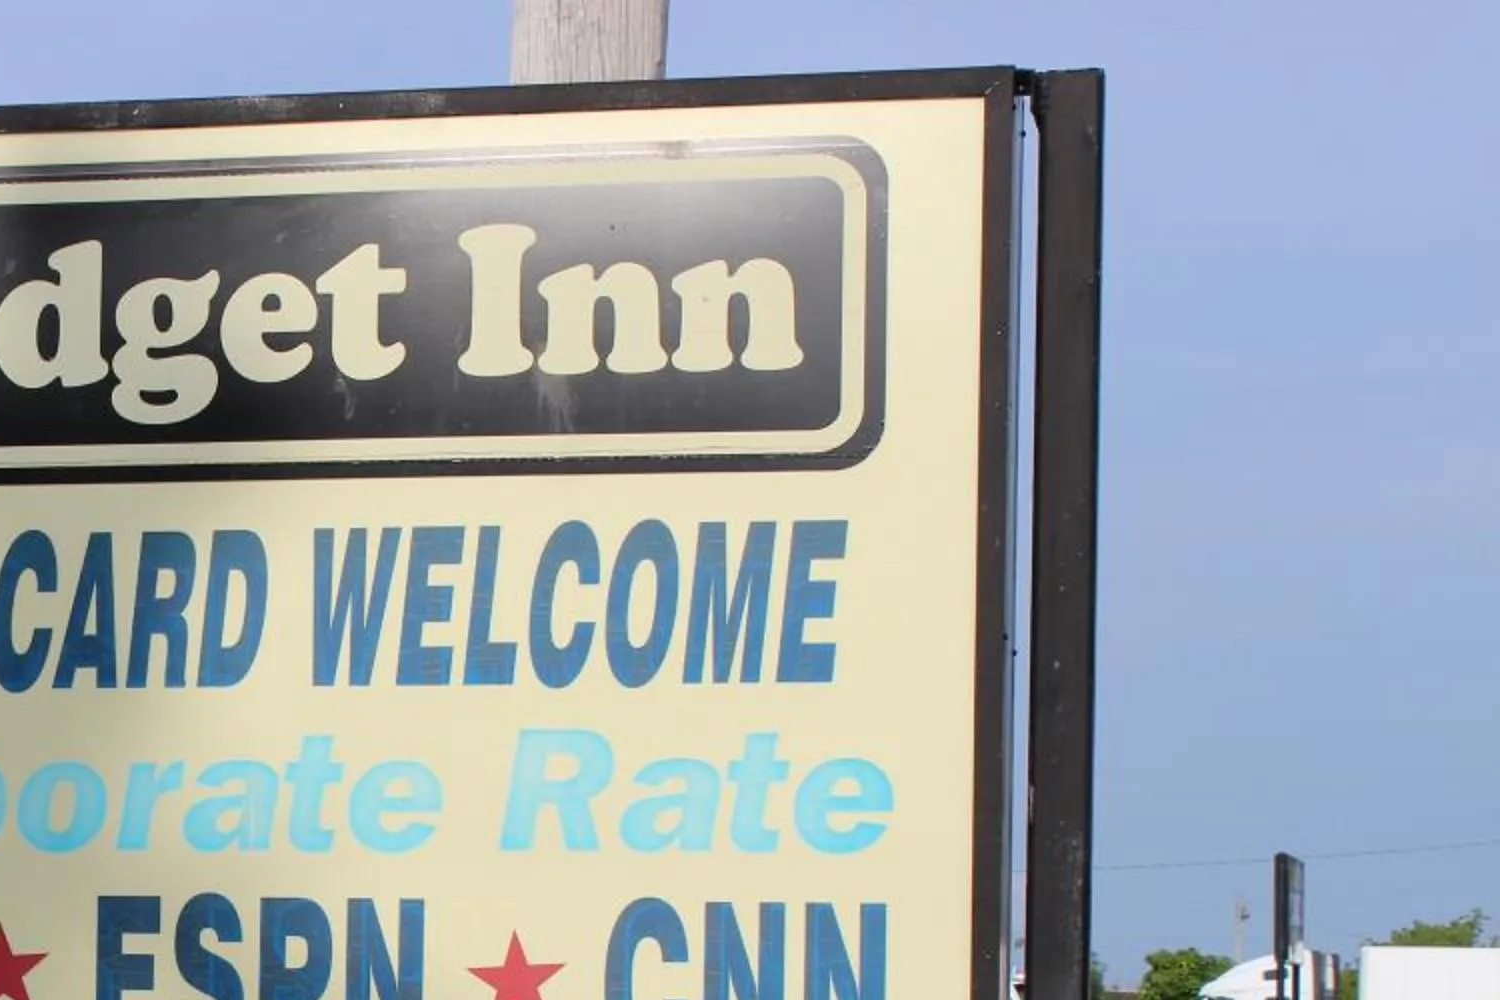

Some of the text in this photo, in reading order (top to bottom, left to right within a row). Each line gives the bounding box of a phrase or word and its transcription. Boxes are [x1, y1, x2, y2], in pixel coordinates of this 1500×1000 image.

[457, 223, 804, 378] Inn
[311, 518, 849, 689] WELCOME
[498, 728, 895, 854] Rate
